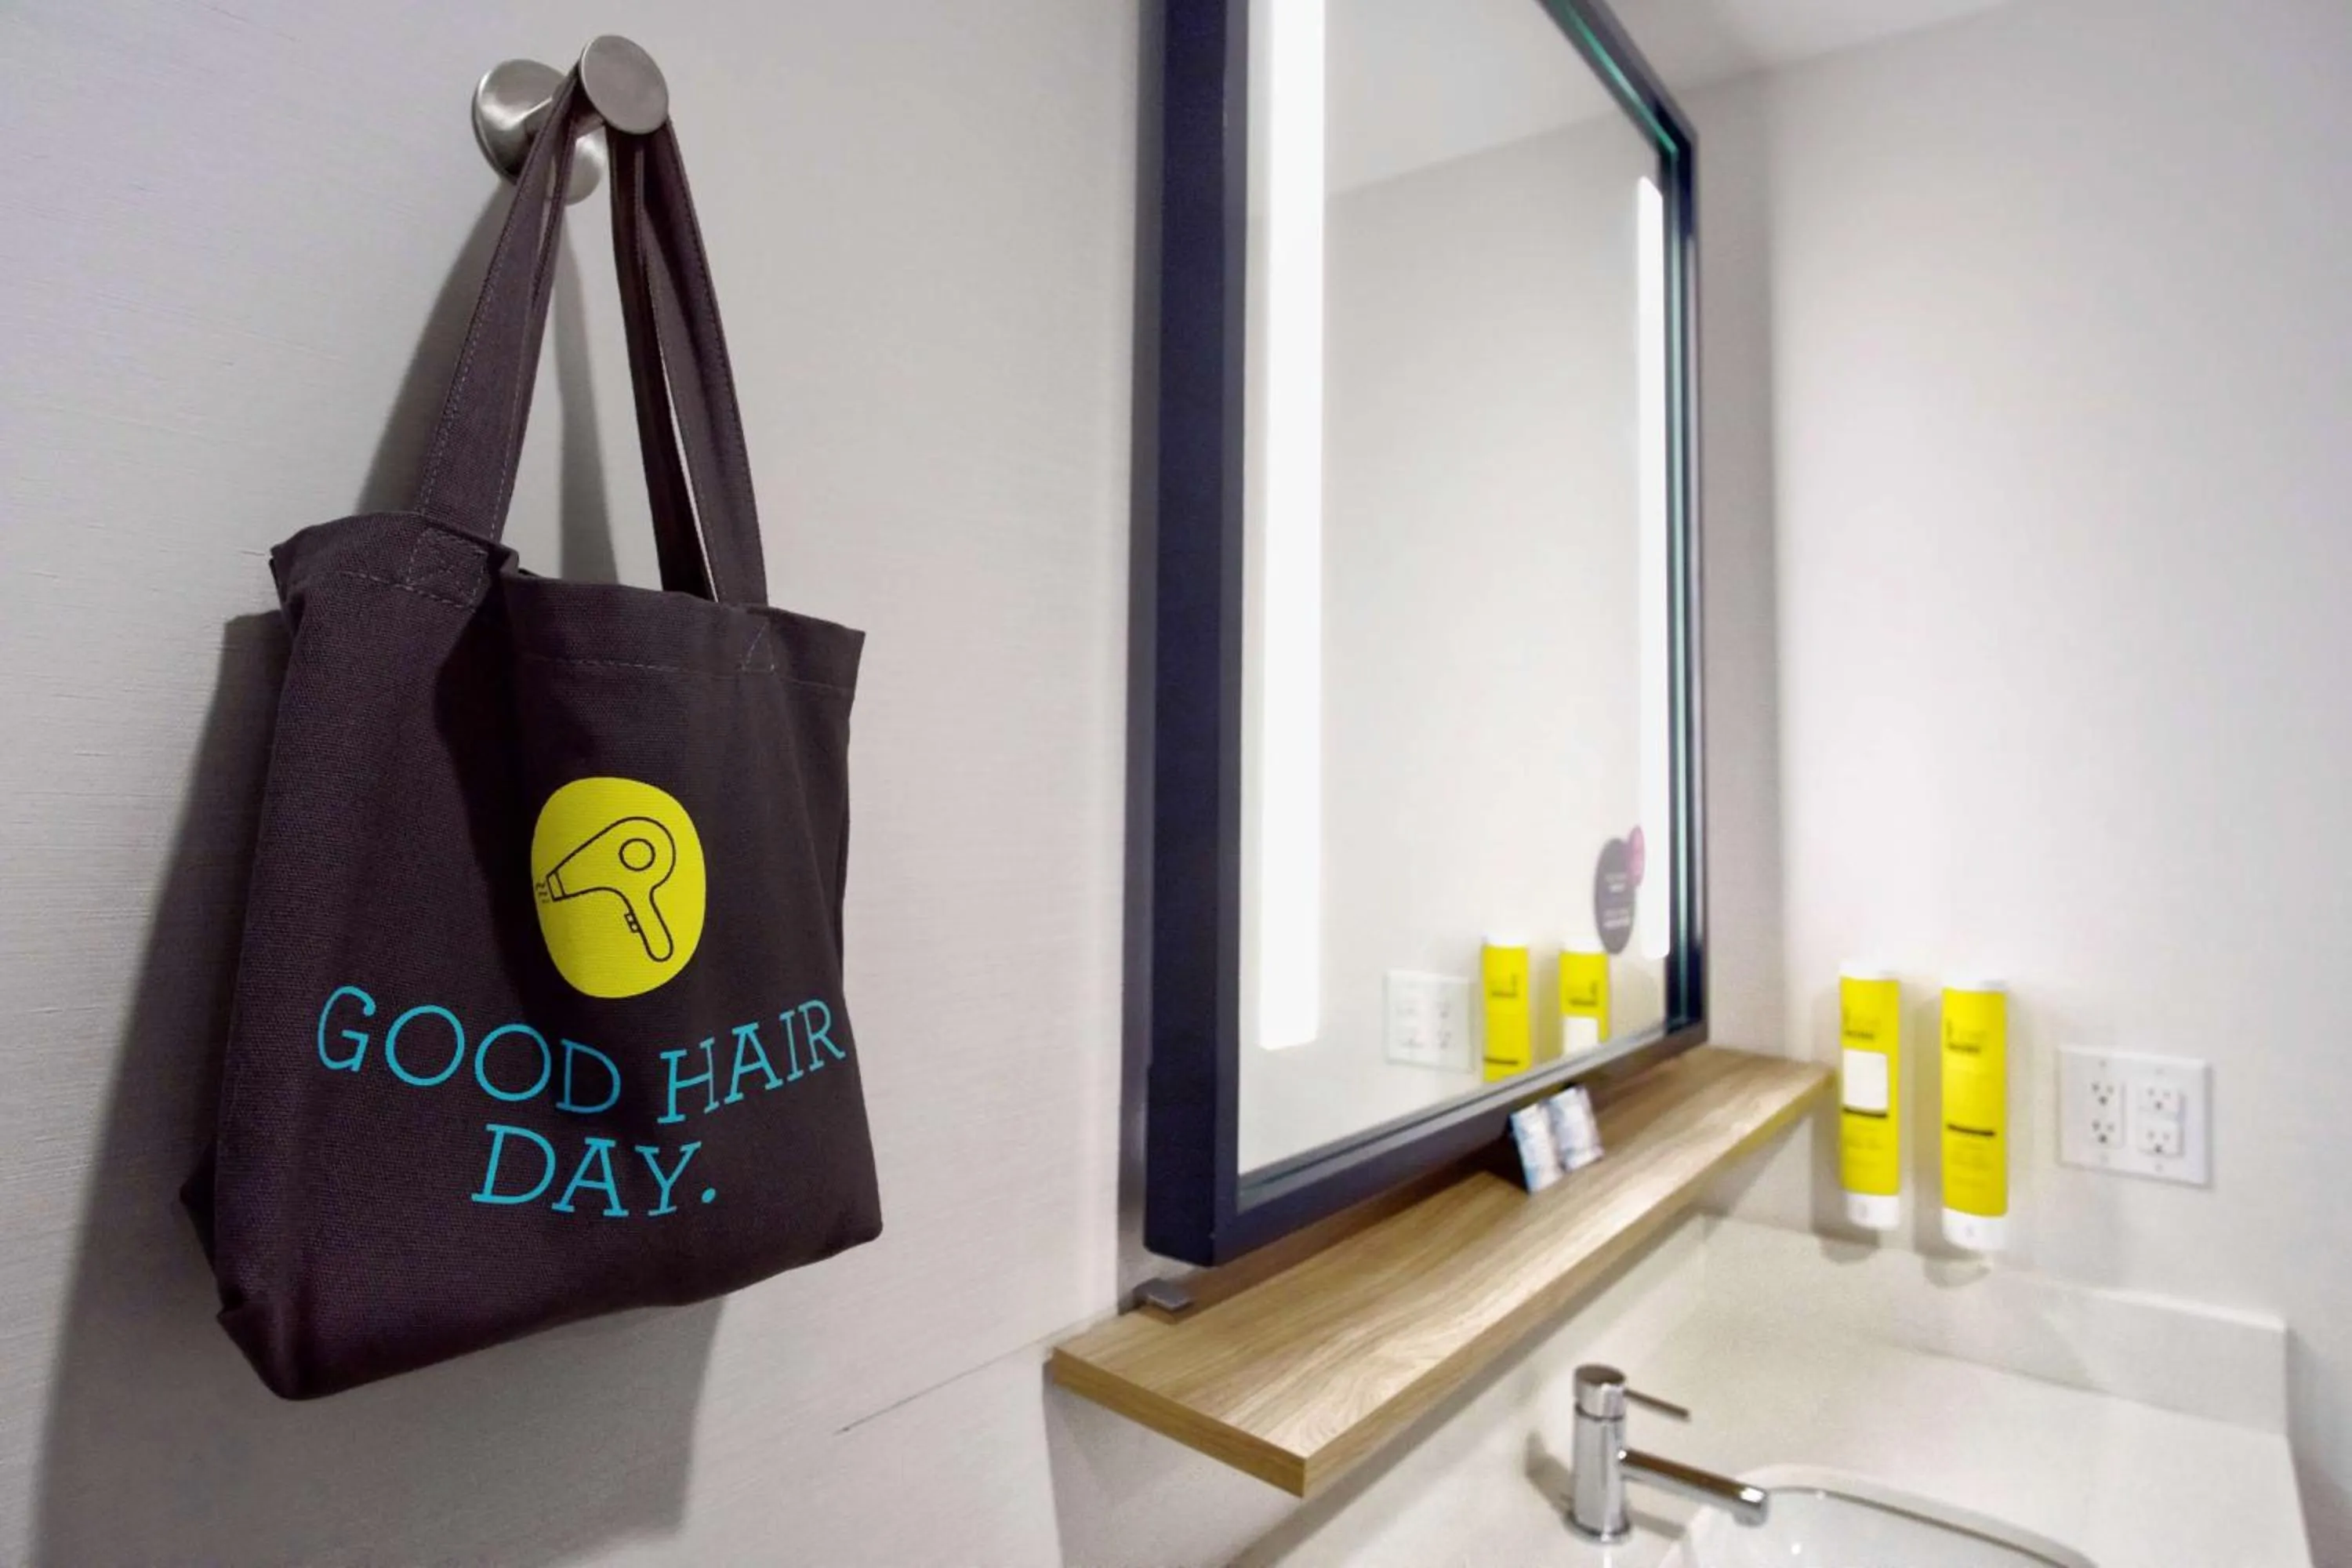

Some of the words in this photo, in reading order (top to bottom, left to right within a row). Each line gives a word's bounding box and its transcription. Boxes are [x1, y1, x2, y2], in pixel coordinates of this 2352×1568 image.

[318, 985, 621, 1113] GOOD
[658, 1000, 846, 1123] HAIR
[472, 1123, 717, 1217] DAY.
